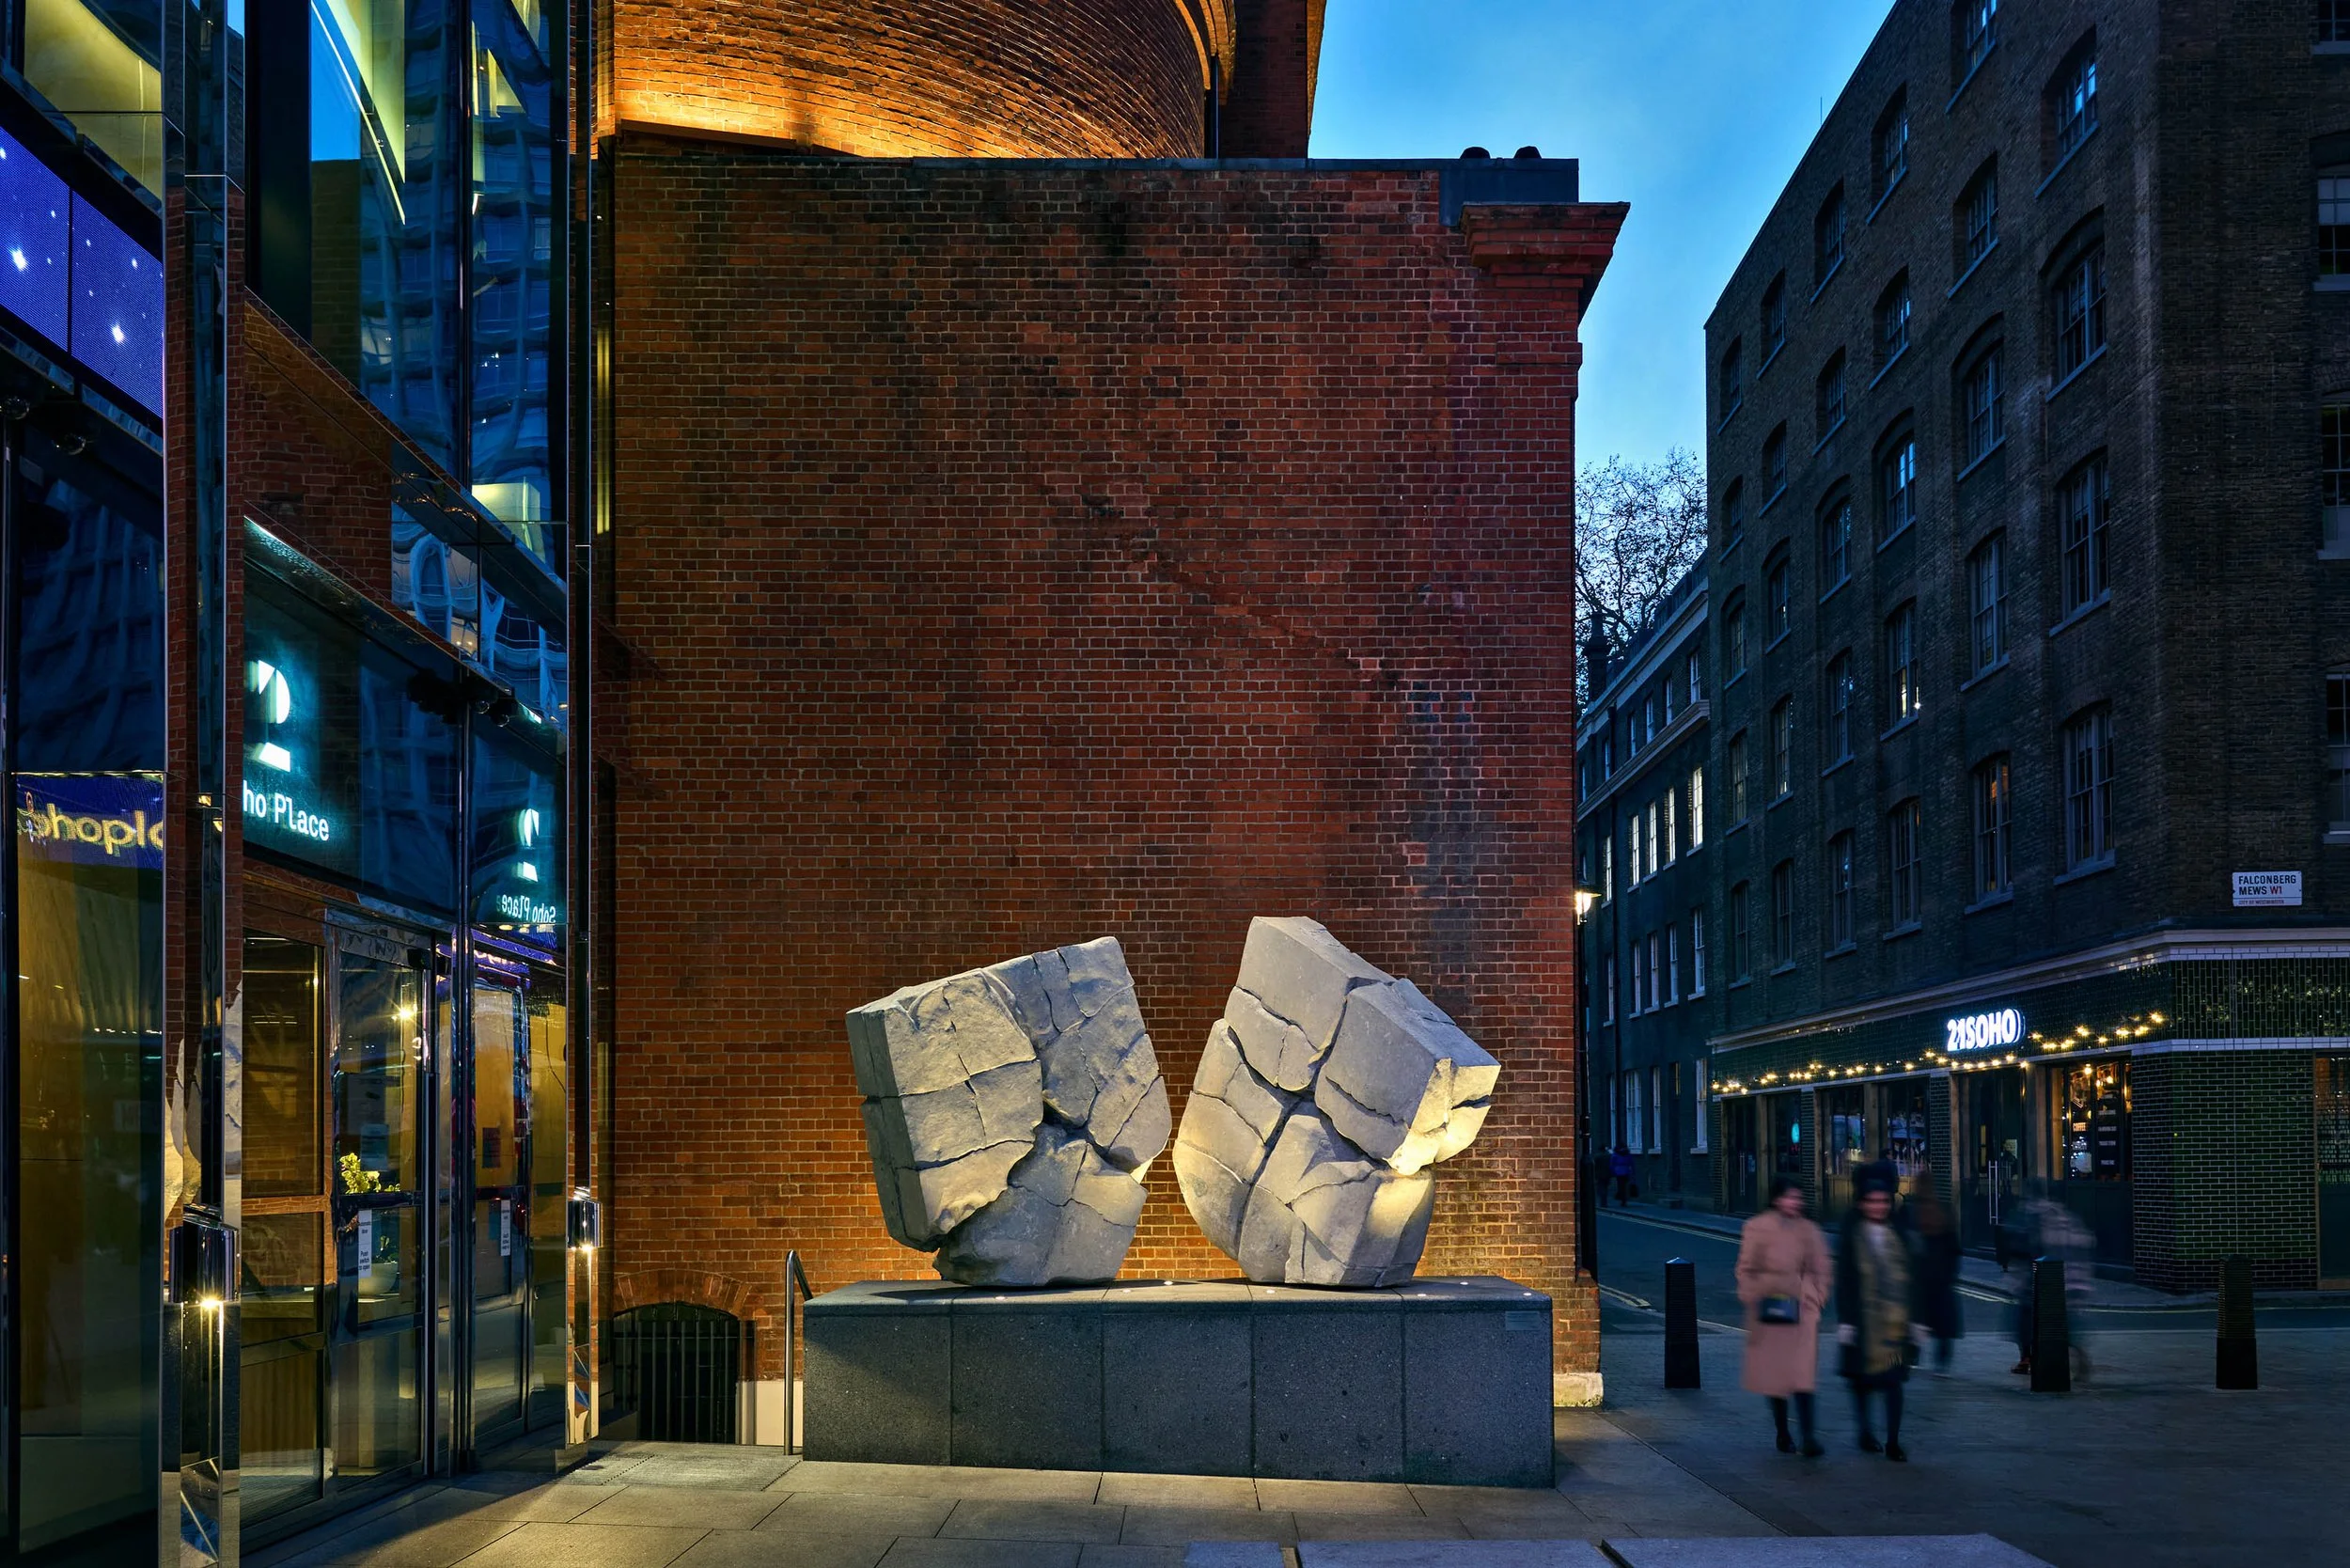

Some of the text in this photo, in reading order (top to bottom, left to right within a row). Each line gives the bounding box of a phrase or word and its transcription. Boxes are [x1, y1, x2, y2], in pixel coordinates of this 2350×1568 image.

[243, 779, 329, 840] ho Place
[2238, 874, 2296, 885] FALCONBERG
[2239, 886, 2282, 895] MEWS W1
[1947, 1009, 2020, 1052] 21SOHO
